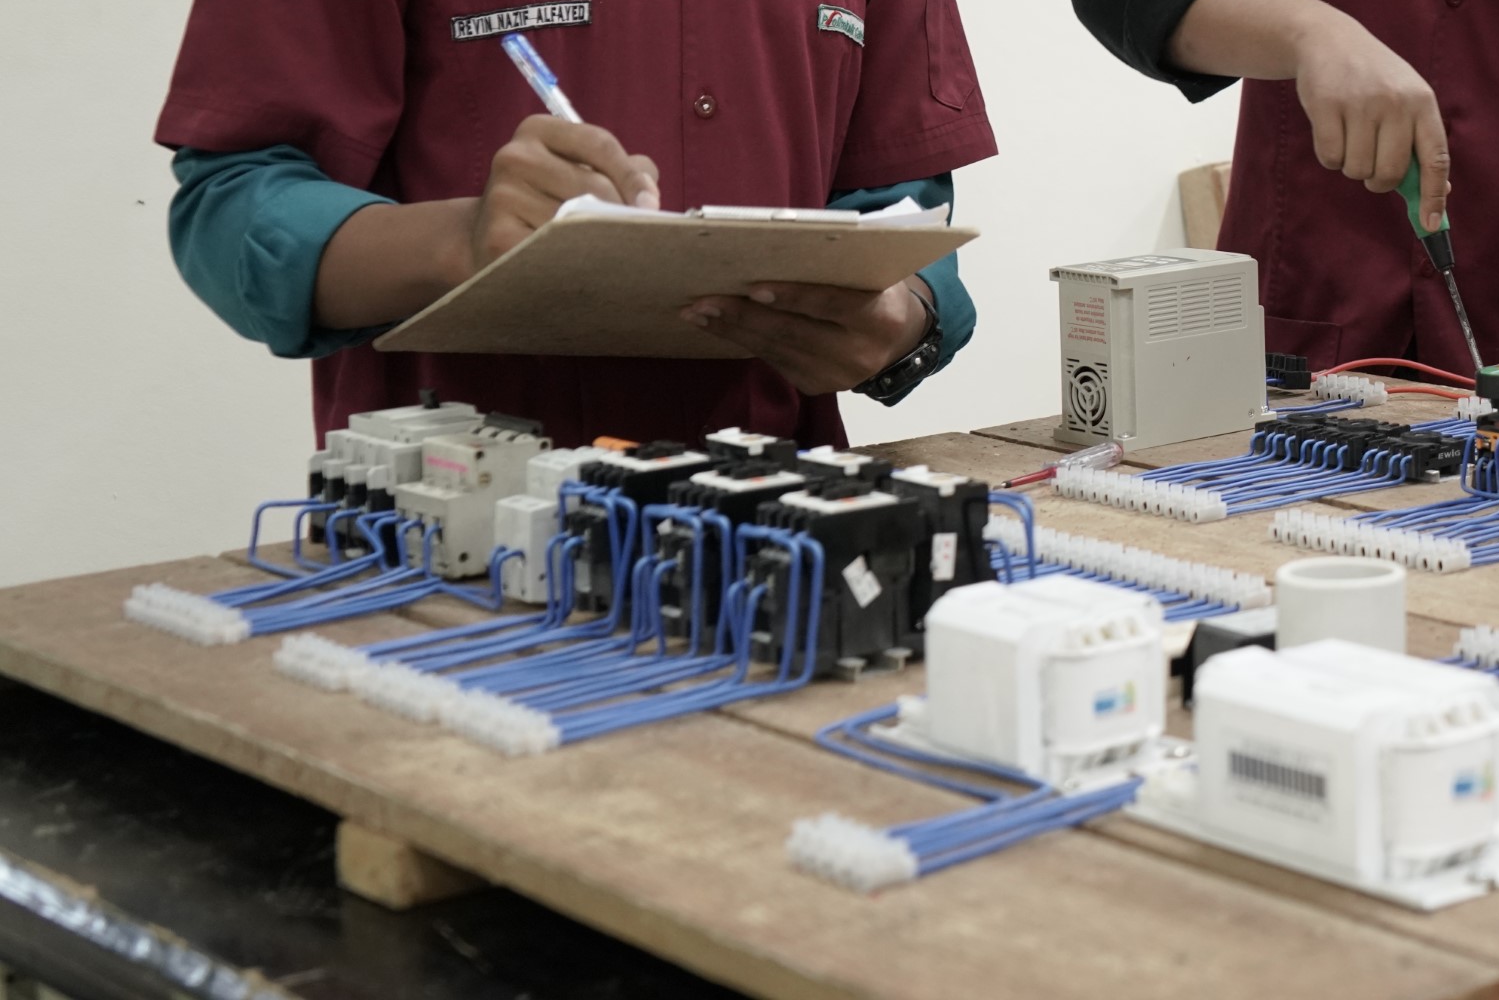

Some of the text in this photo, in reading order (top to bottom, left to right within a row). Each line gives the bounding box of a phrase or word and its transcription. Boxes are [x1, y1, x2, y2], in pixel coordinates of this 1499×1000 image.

[458, 5, 585, 37] REVIN NAZIF ALFAYED
